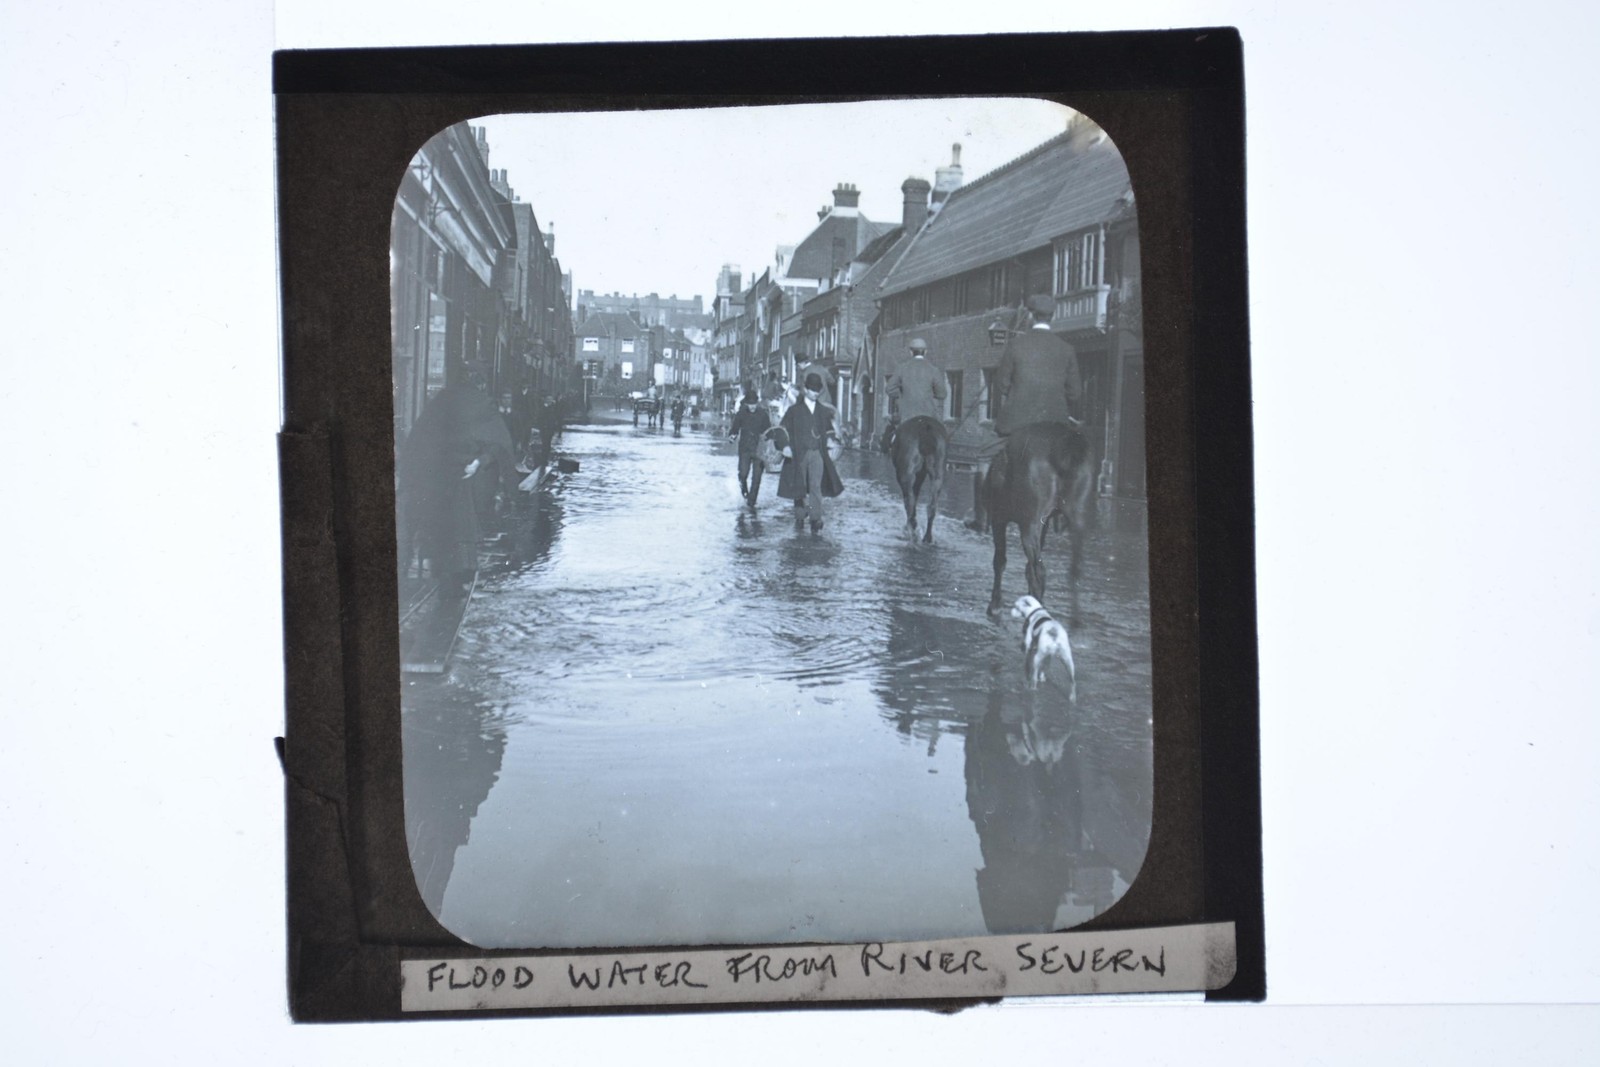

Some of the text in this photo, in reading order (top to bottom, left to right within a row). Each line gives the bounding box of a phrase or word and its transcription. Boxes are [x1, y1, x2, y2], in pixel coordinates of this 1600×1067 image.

[427, 942, 1165, 992] FLOOD WATER FROM RIVER SEVERN
